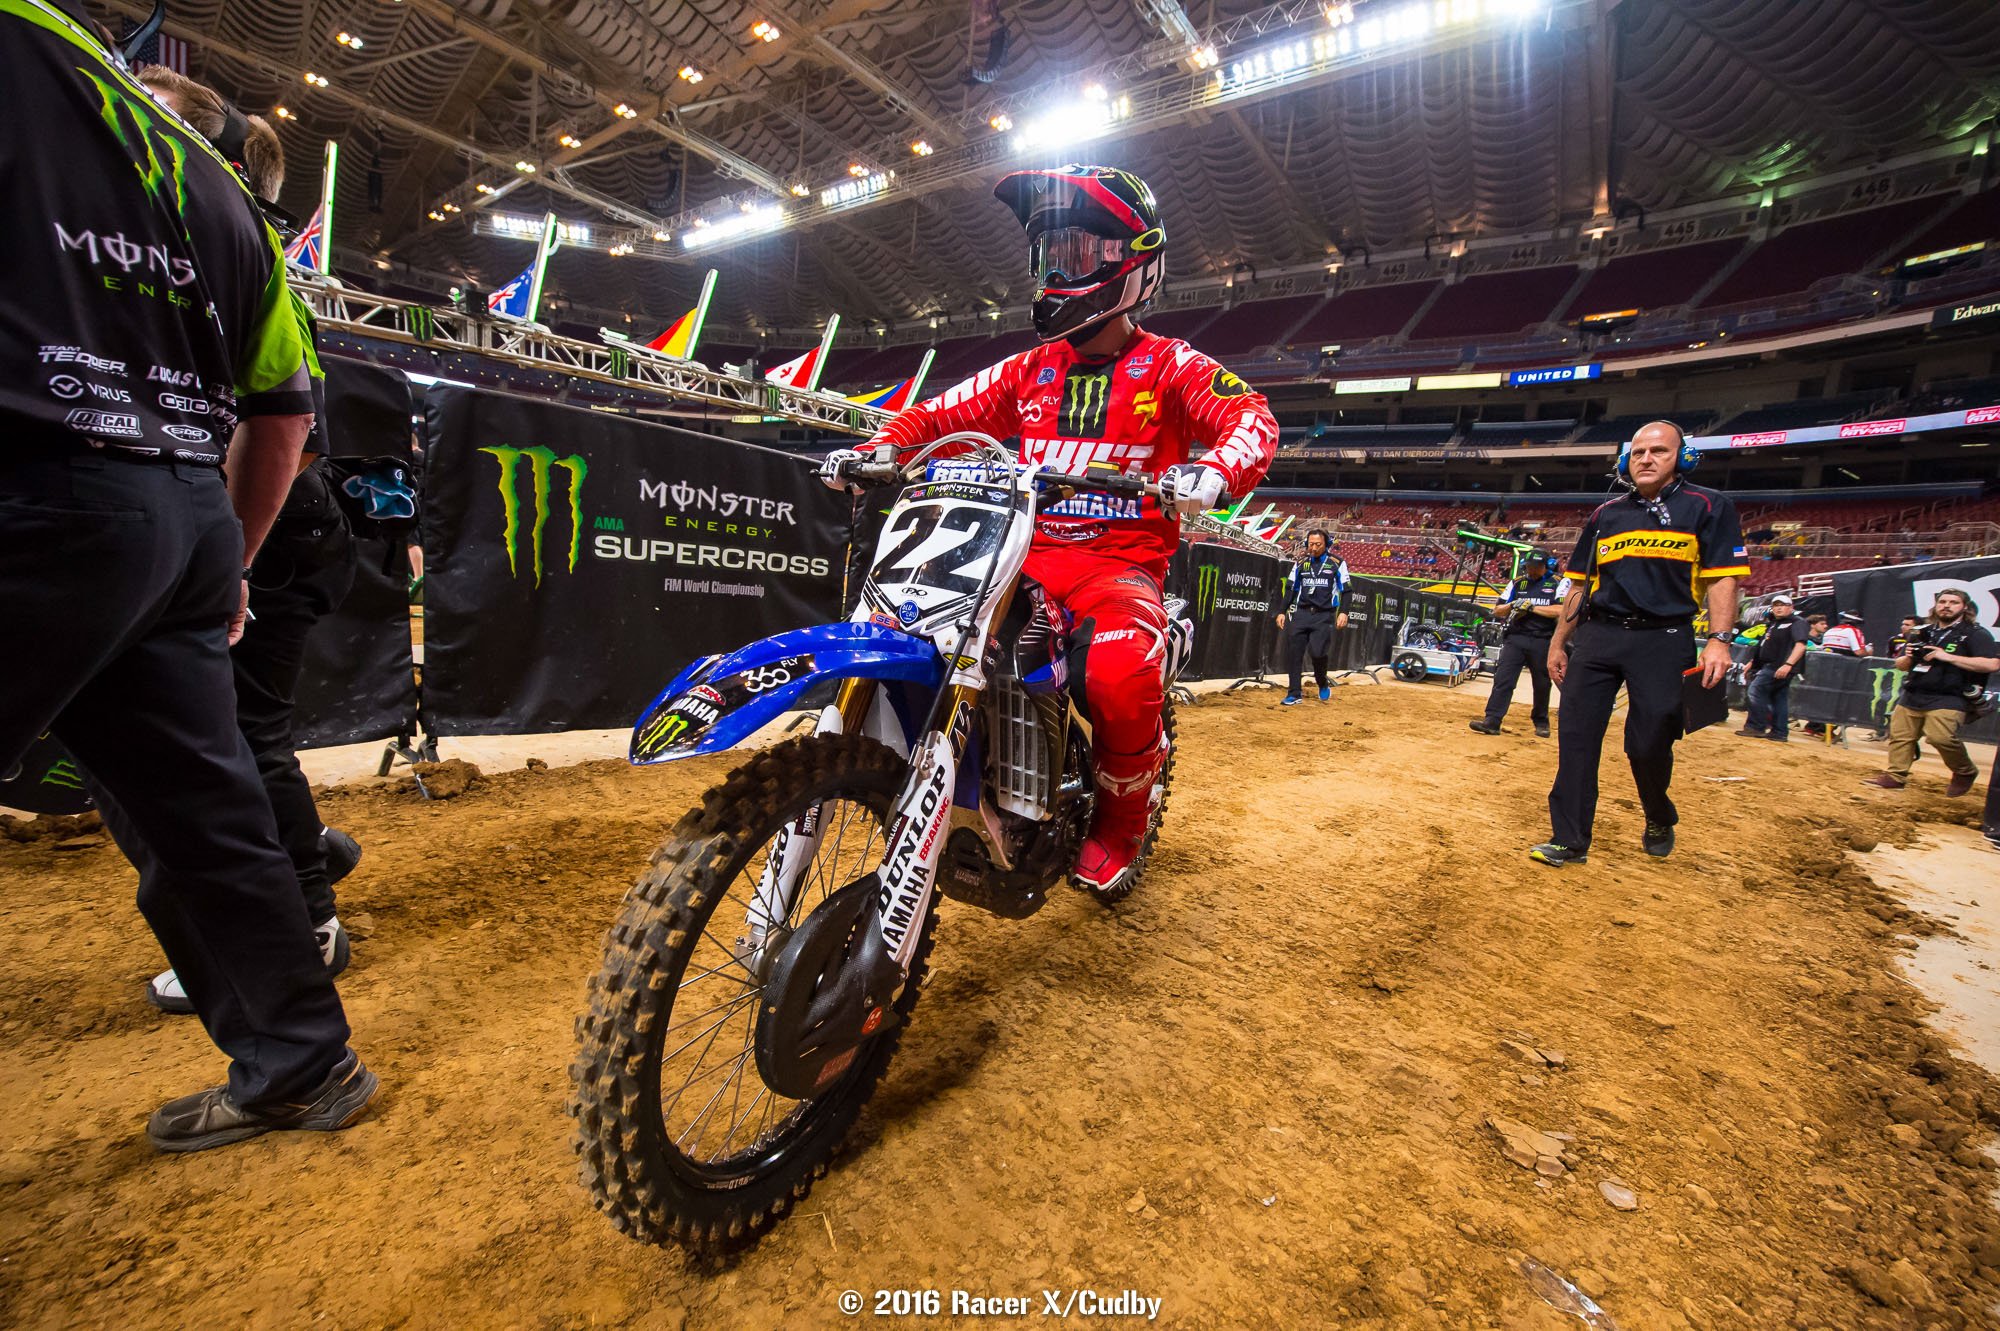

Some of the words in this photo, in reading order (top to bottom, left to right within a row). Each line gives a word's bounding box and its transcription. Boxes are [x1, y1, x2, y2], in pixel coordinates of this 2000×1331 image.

[1664, 220, 1695, 238] 445
[1952, 301, 2000, 322] Edwar
[1517, 369, 1572, 383] UNITED
[1042, 395, 1060, 406] FLY
[638, 478, 797, 526] MONSTER
[1044, 493, 1140, 519] AMAHA
[594, 516, 625, 531] AMA
[664, 515, 773, 539] ENERGY
[869, 504, 1011, 596] 22
[1612, 538, 1689, 552] DUNLOP
[1634, 548, 1685, 558] MOTORSPORT
[594, 535, 830, 577] SUPERCROSS
[664, 578, 682, 592] FIM
[684, 579, 710, 594] World
[711, 581, 765, 599] Championship
[874, 614, 899, 628] GET
[1092, 629, 1137, 646] SHIFT
[781, 657, 798, 668] FLY
[918, 796, 950, 863] BRAKING
[877, 764, 947, 919] DUNLOP
